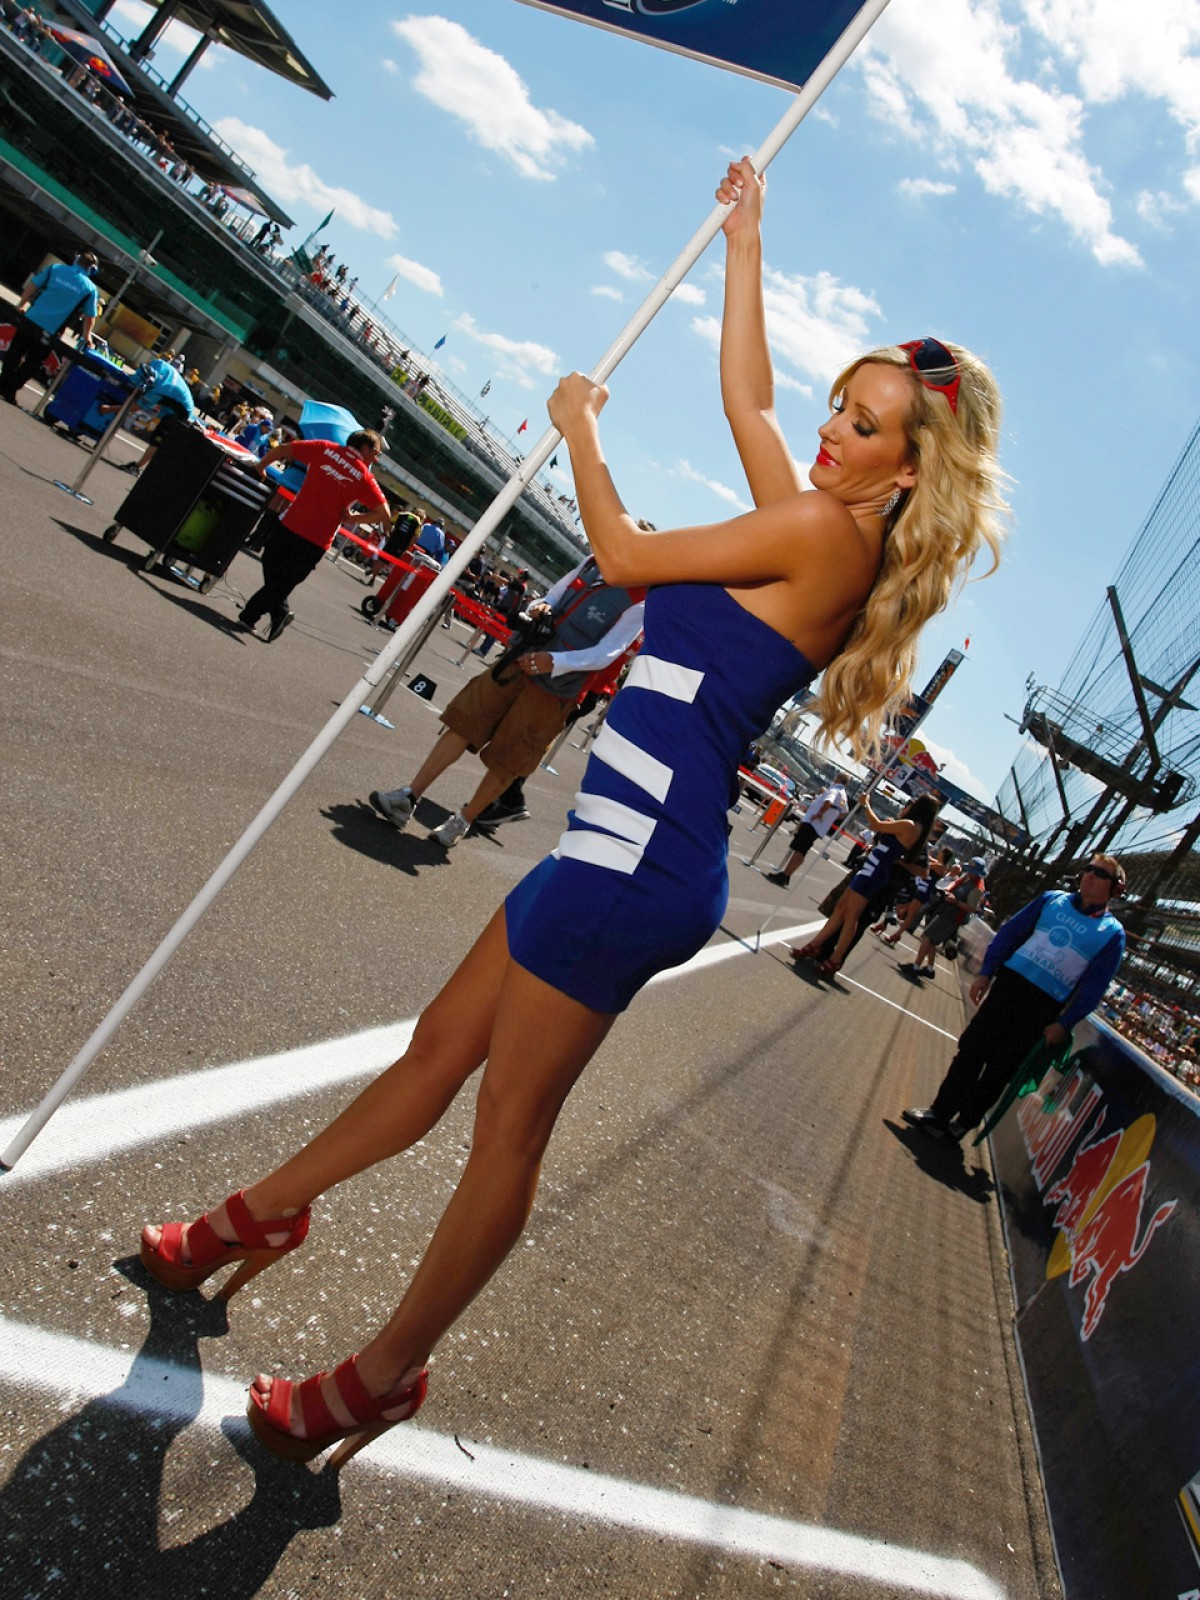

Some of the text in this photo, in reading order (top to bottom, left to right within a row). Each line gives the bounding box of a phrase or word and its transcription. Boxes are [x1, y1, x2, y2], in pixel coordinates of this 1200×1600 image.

[324, 448, 363, 480] MAPFRE
[414, 681, 427, 693] 8
[1056, 912, 1087, 935] GRID
